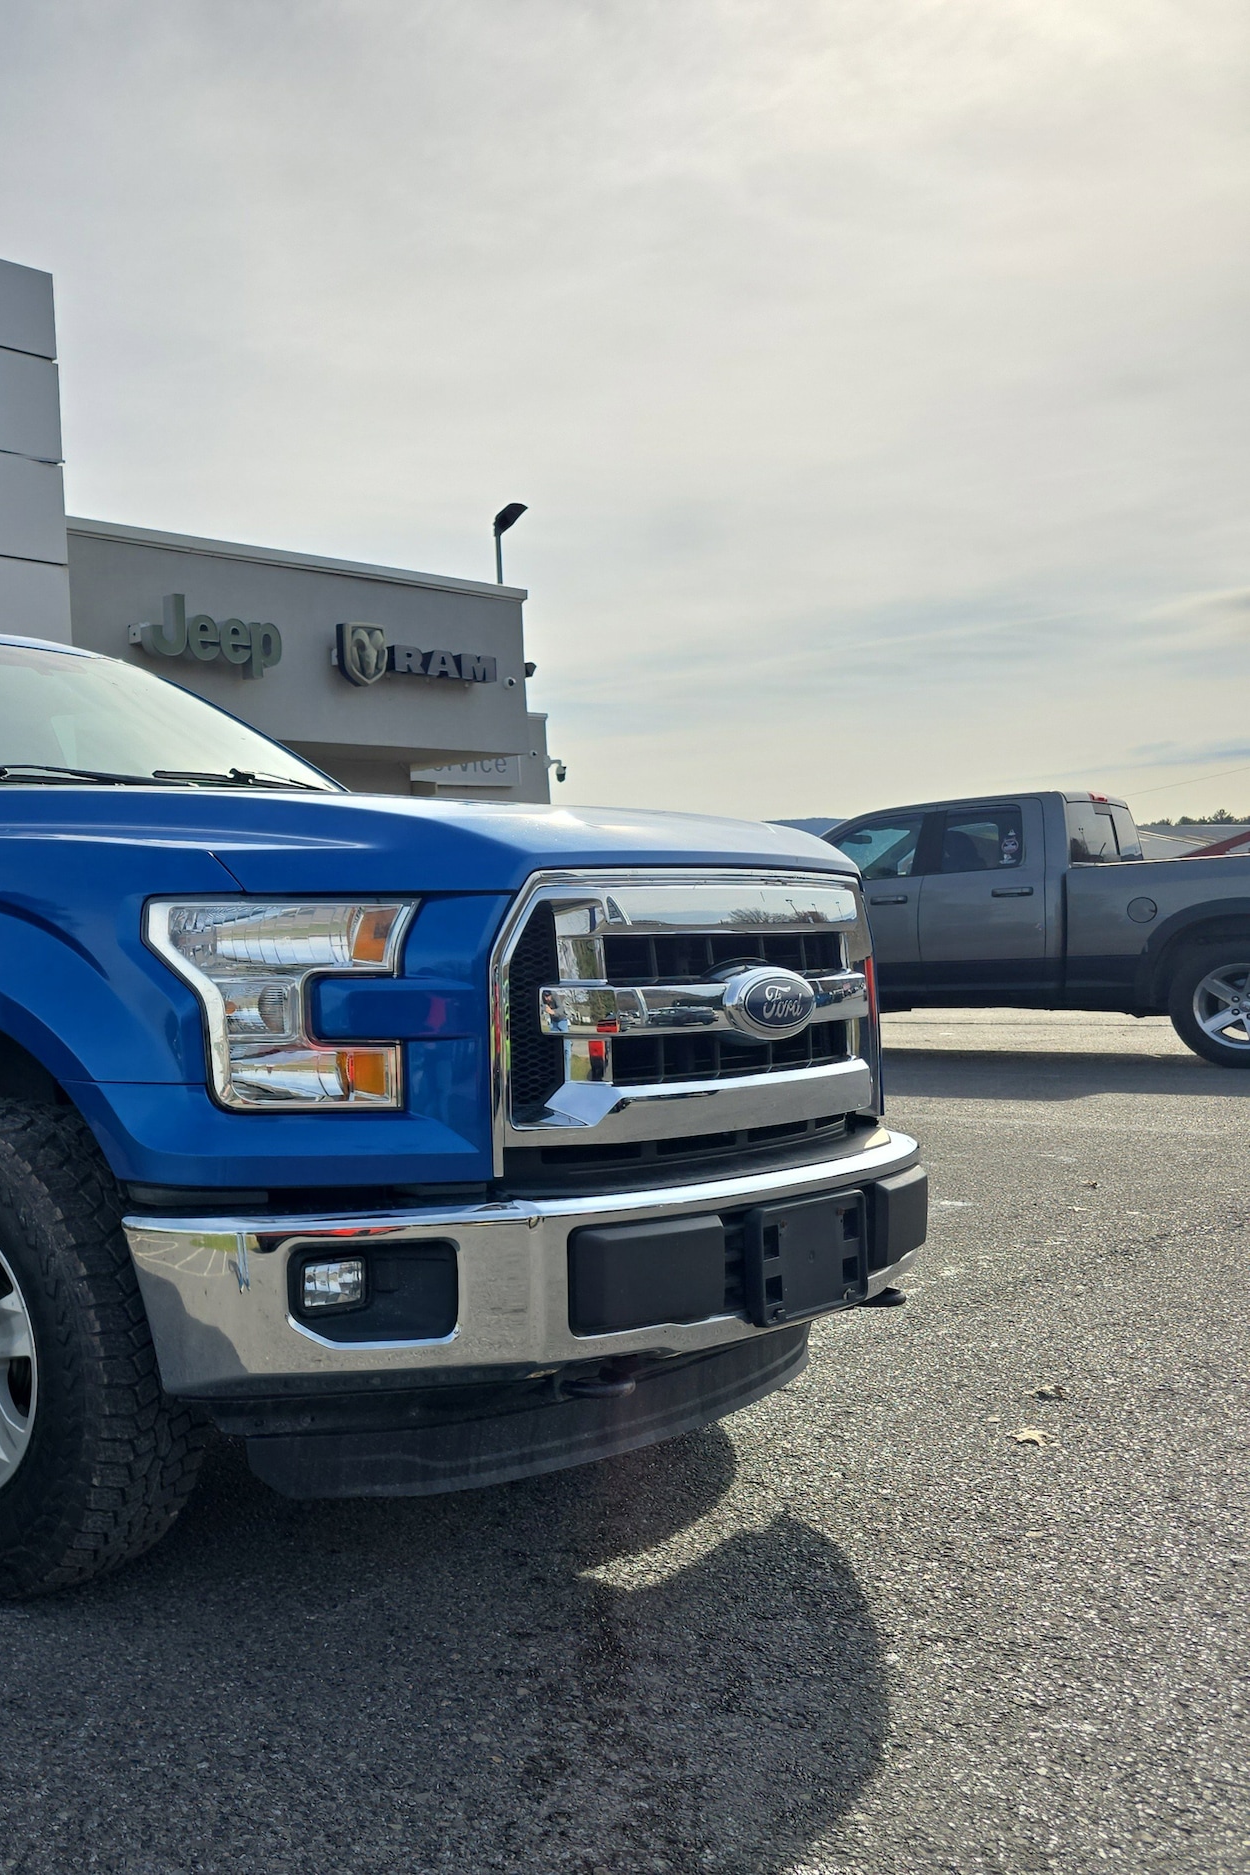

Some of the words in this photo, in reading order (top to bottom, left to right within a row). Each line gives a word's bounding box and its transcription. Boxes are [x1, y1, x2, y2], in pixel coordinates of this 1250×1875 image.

[141, 593, 282, 680] Jeep
[387, 644, 497, 683] RAM
[763, 985, 803, 1019] Ford
